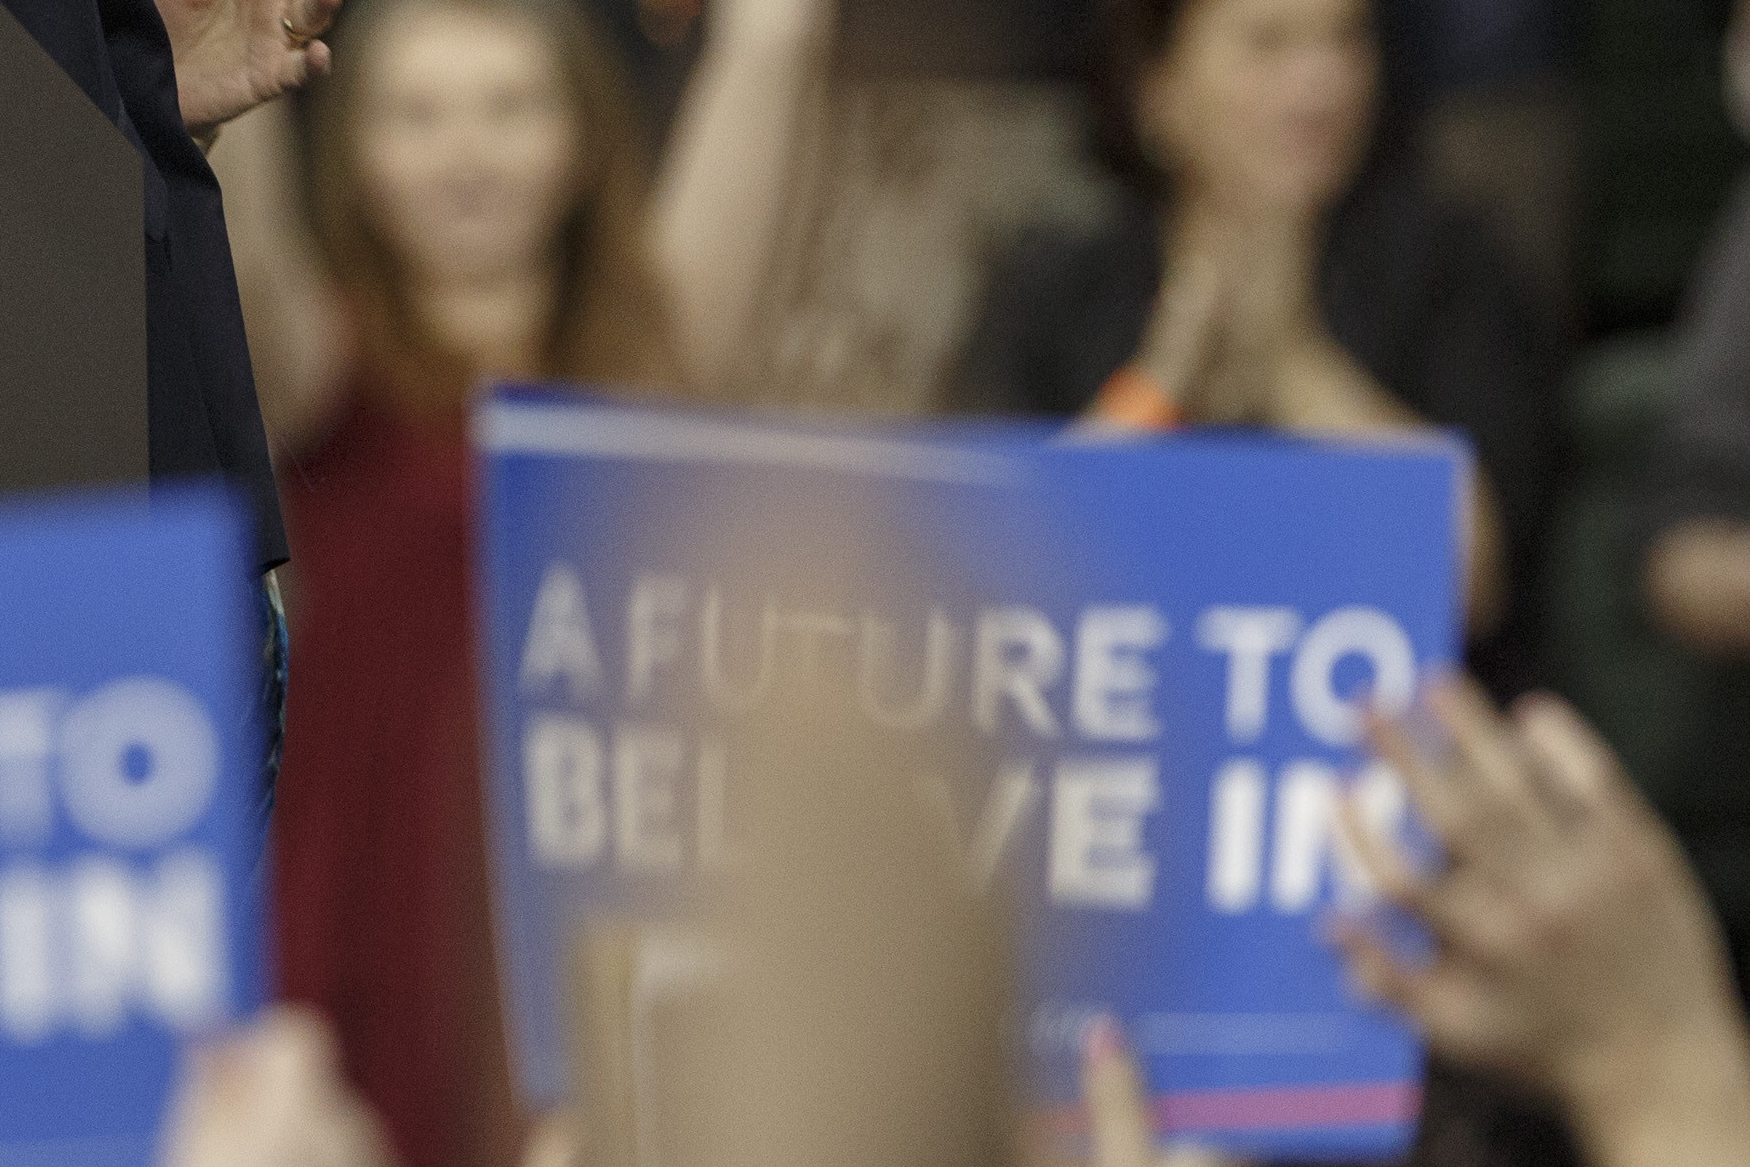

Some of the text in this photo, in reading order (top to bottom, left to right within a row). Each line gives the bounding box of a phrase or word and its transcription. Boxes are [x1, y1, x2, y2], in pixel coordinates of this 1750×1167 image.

[519, 564, 1418, 745] A FUTURE TO
[1203, 758, 1405, 917] IN
